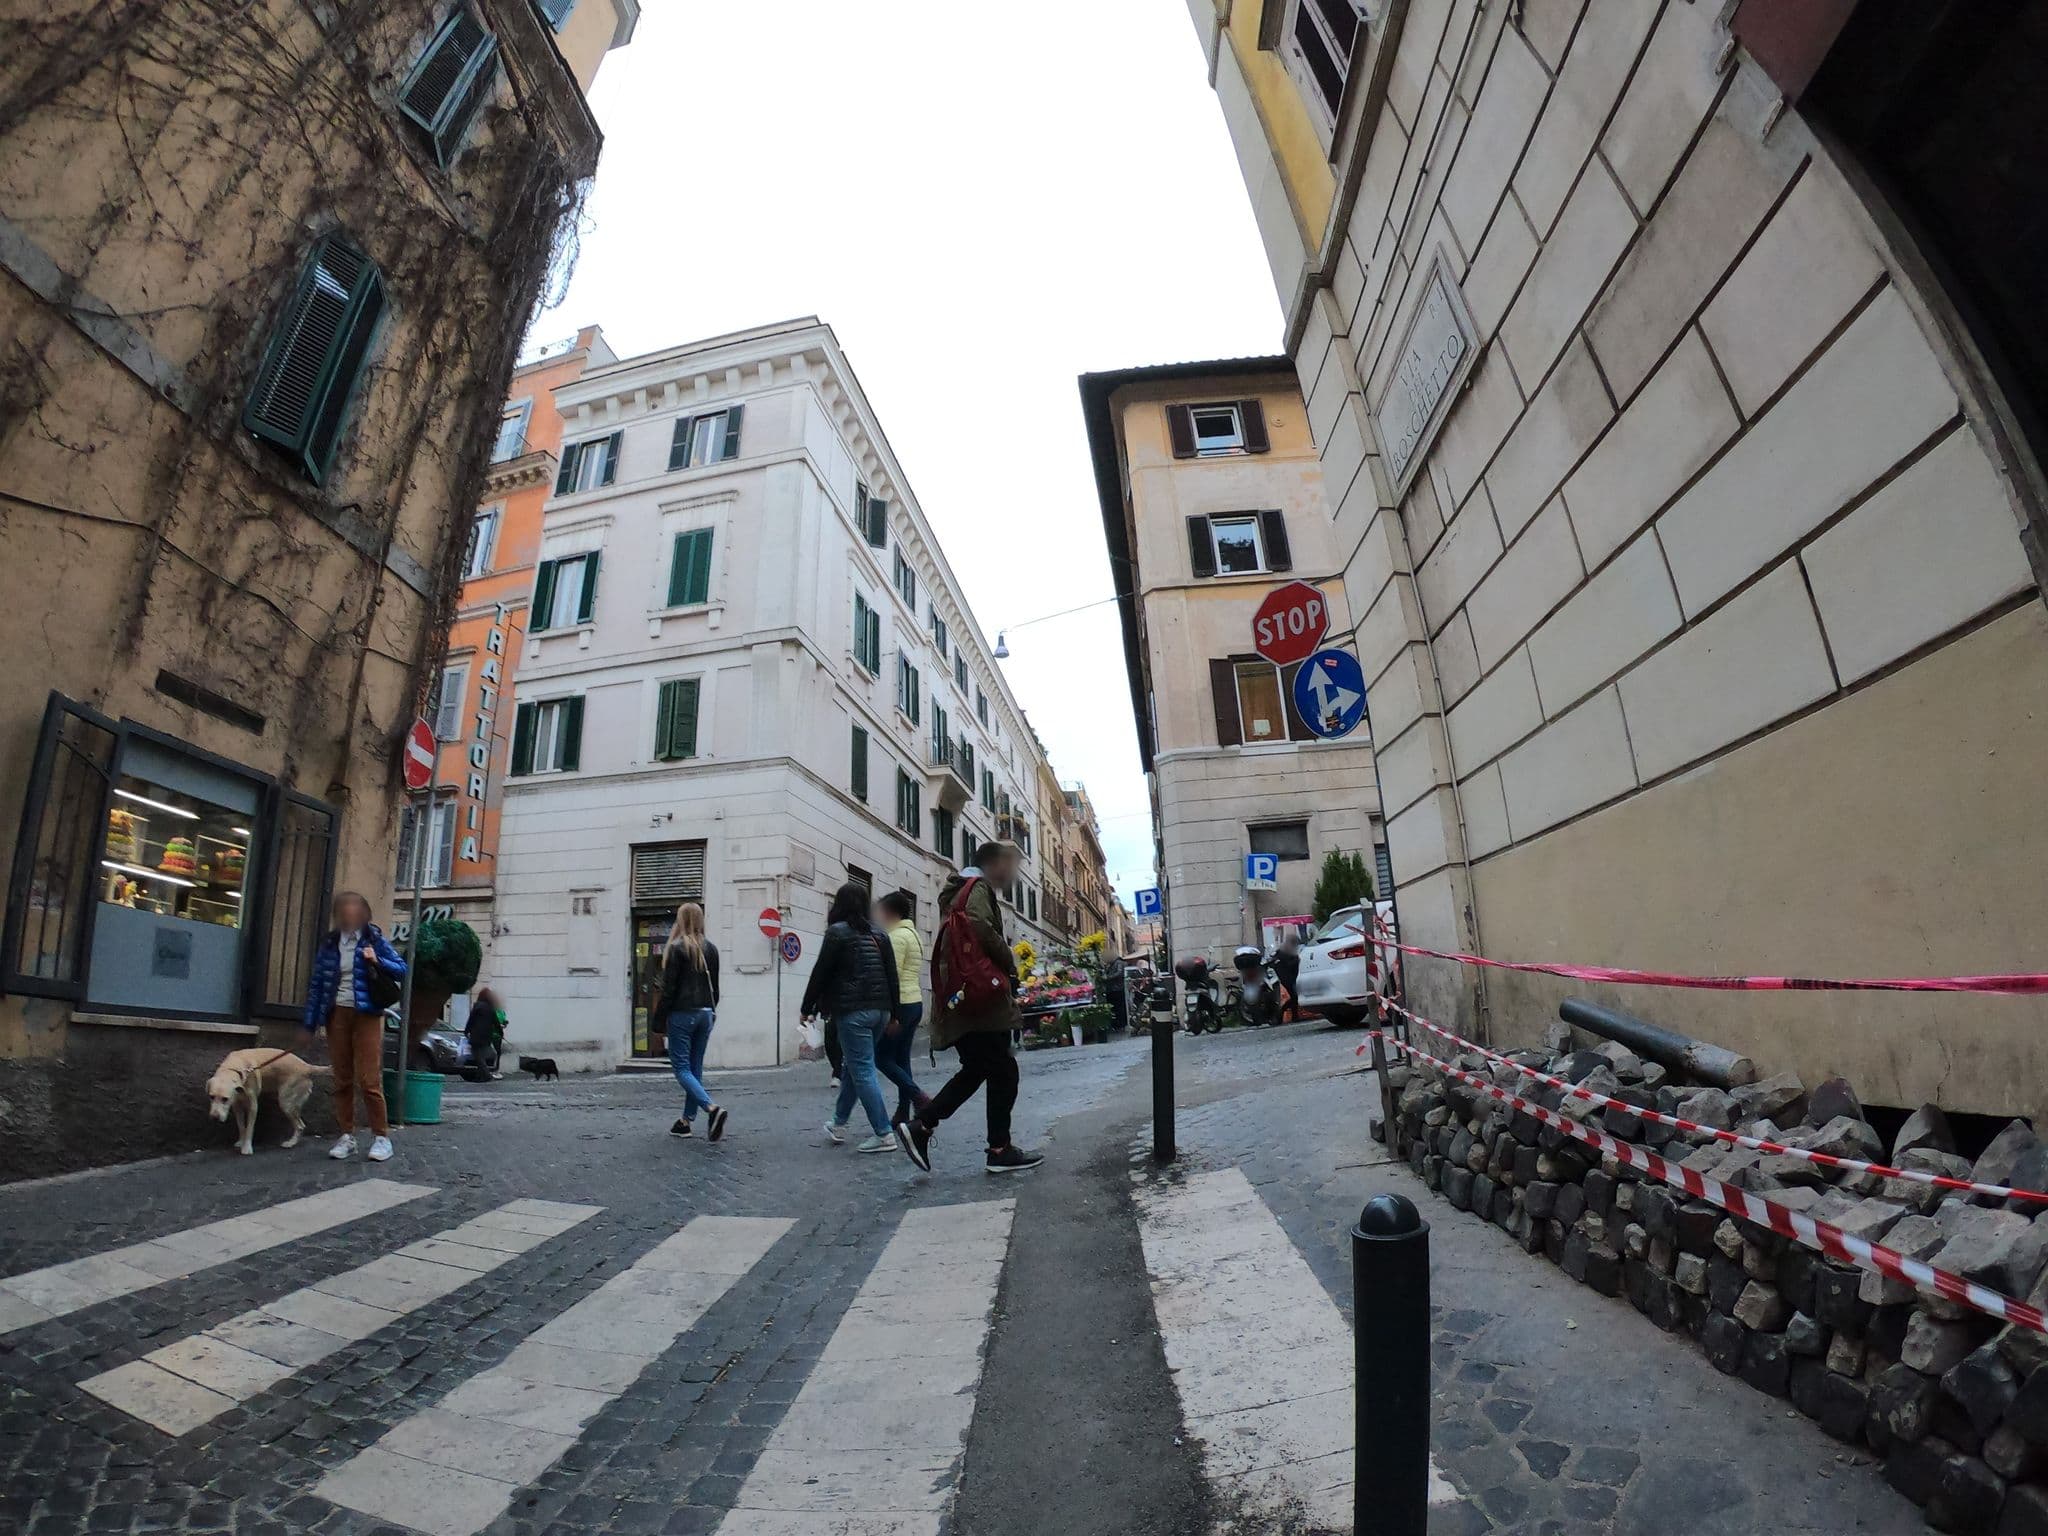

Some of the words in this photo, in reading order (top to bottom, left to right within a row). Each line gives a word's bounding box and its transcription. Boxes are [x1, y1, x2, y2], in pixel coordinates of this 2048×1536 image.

[1400, 349, 1422, 388] VIA
[1409, 372, 1427, 403] DEL
[1393, 334, 1460, 473] BOSCHETTO
[1256, 599, 1322, 646] STOP
[460, 602, 507, 863] TRATTORIA
[1254, 857, 1274, 880] P
[1140, 891, 1157, 914] P
